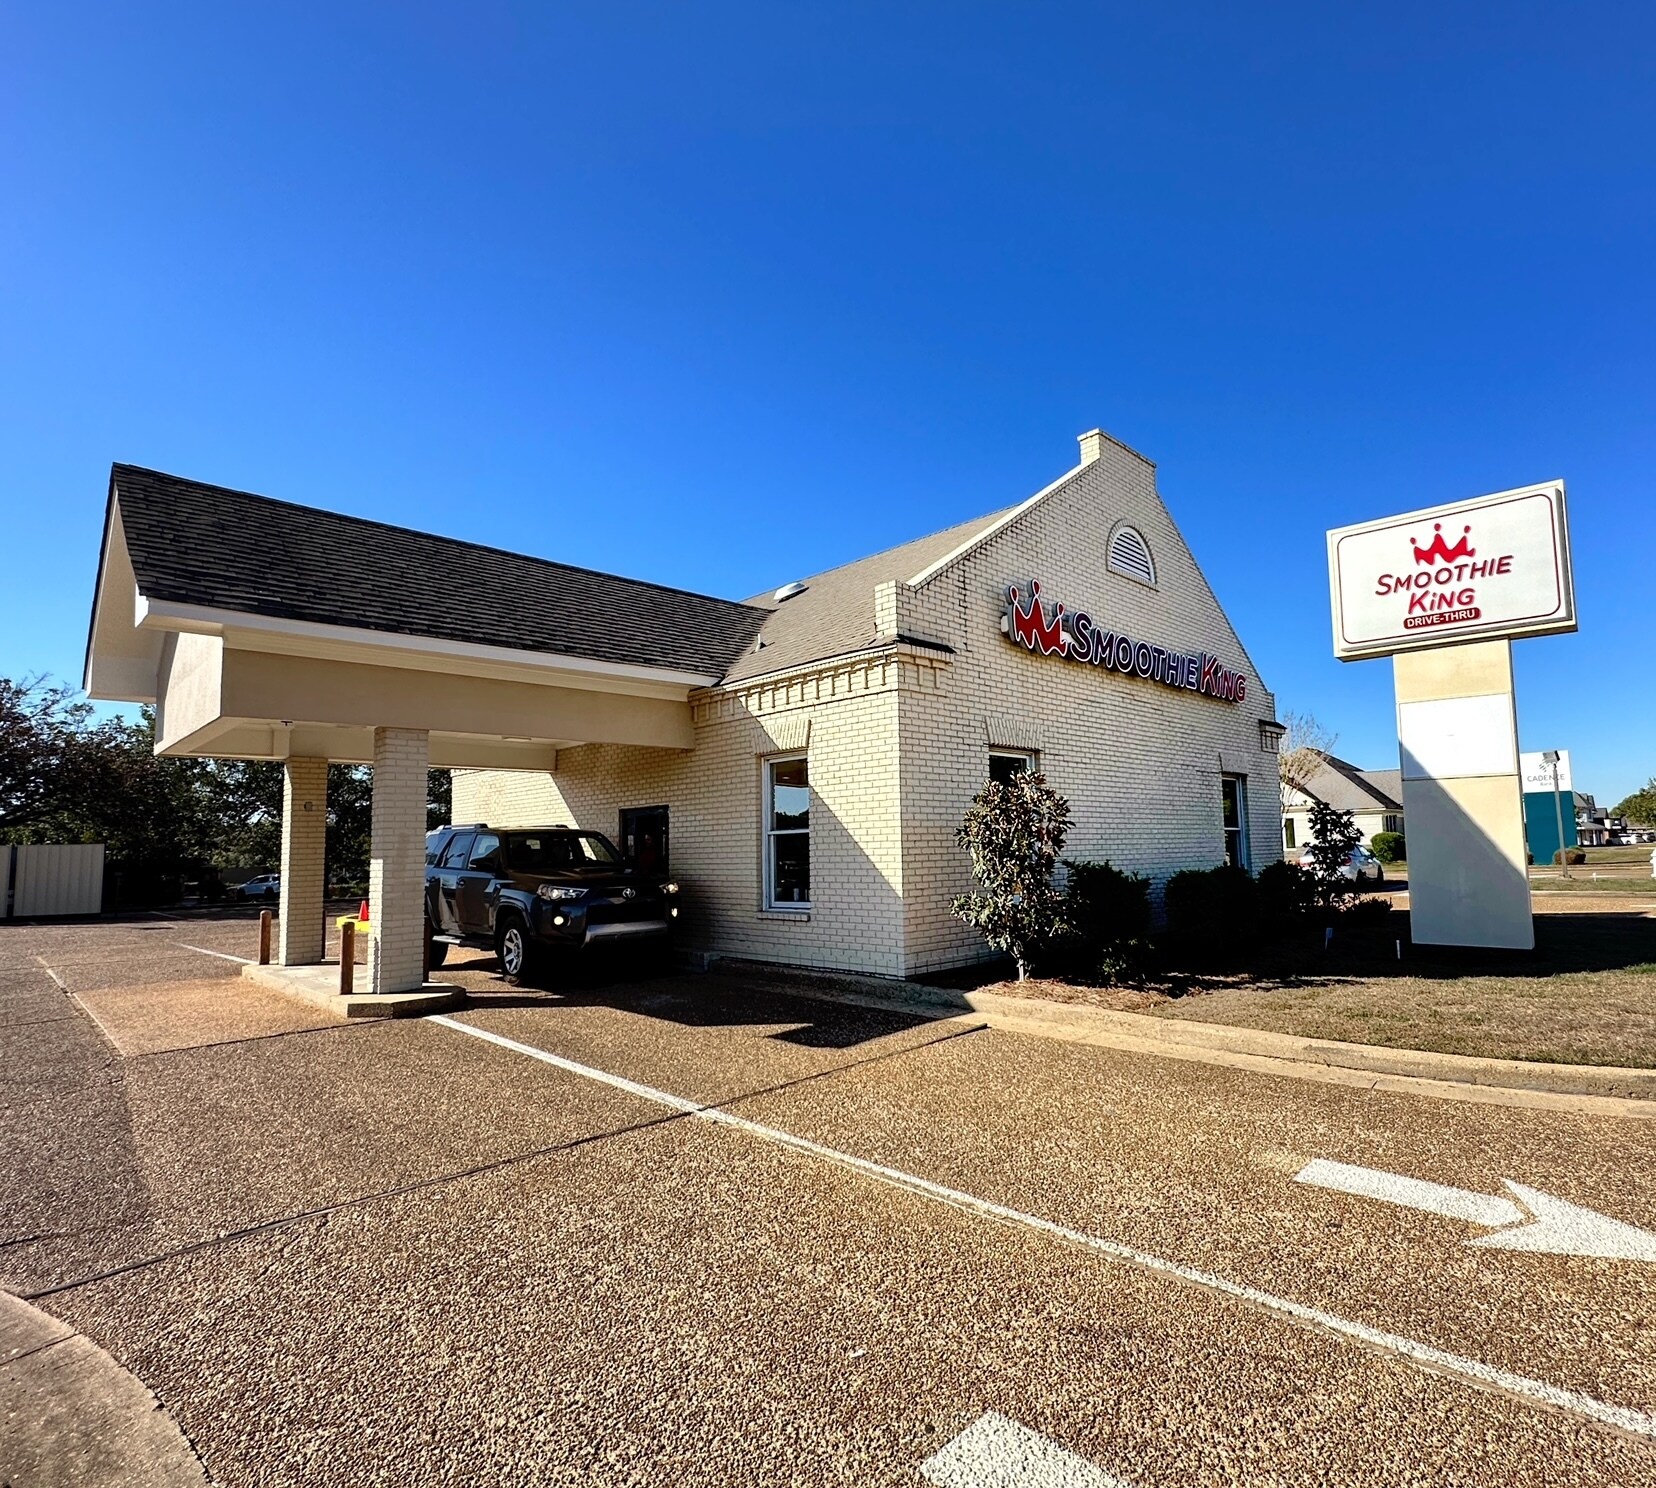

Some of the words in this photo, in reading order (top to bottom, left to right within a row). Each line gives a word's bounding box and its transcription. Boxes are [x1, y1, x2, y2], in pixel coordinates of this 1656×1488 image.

[1375, 555, 1514, 596] SMOOTHIE
[1407, 609, 1476, 628] DRIVE-THRU
[1070, 611, 1199, 690] SMOOTHIE
[1527, 773, 1566, 782] CADENE
